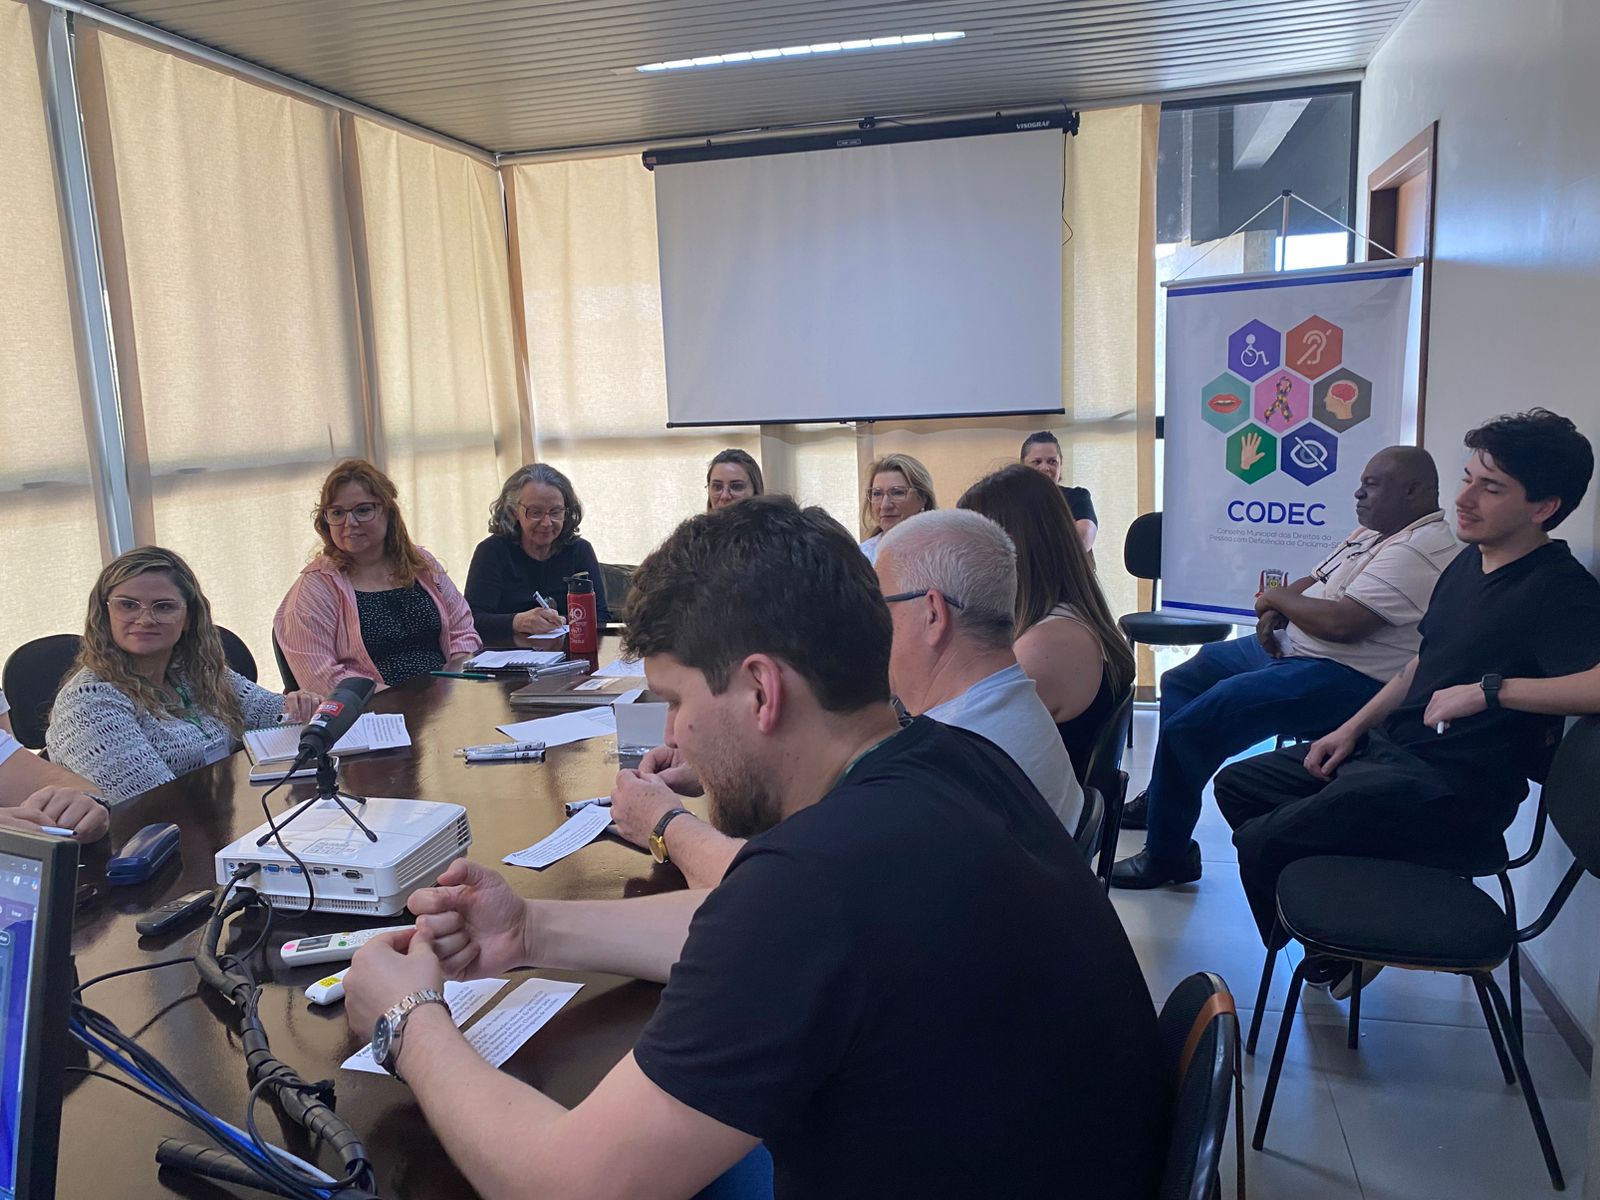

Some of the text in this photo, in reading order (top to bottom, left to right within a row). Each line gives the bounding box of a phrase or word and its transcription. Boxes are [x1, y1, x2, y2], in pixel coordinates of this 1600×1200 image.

[1016, 120, 1050, 129] VISOGRAF
[1227, 500, 1326, 526] CODEC
[1209, 534, 1232, 542] Pessoa
[1247, 529, 1277, 539] Municipal
[1278, 531, 1291, 539] dos
[1293, 532, 1320, 540] Direitos
